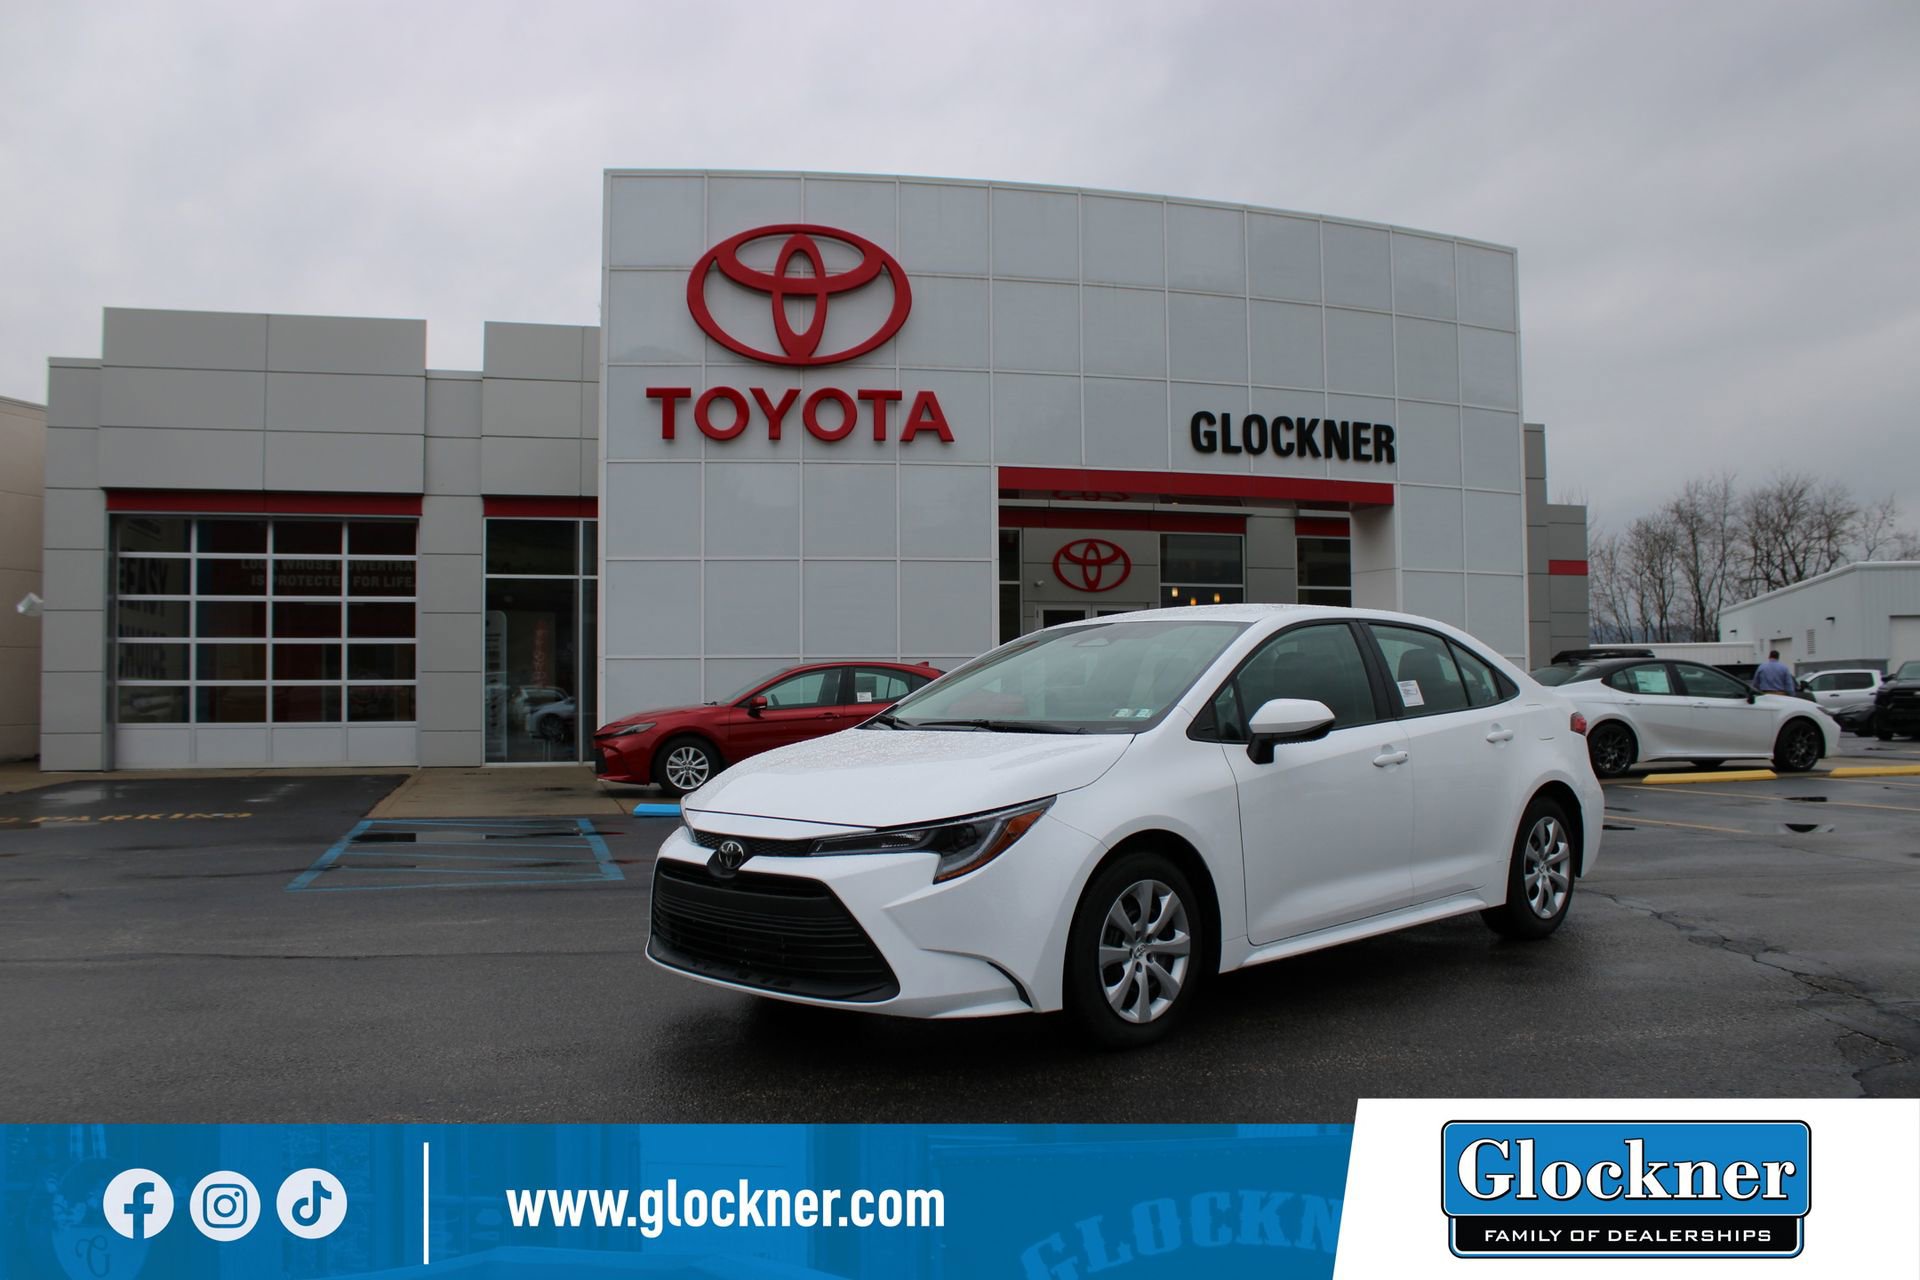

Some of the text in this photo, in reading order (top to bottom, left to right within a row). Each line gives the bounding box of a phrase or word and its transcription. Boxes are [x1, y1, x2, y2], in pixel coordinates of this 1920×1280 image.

[646, 386, 955, 442] TOYOTA
[1190, 410, 1396, 464] GLOCKNER
[251, 574, 265, 586] IS
[353, 575, 380, 587] FOR
[280, 559, 333, 571] WHOSE
